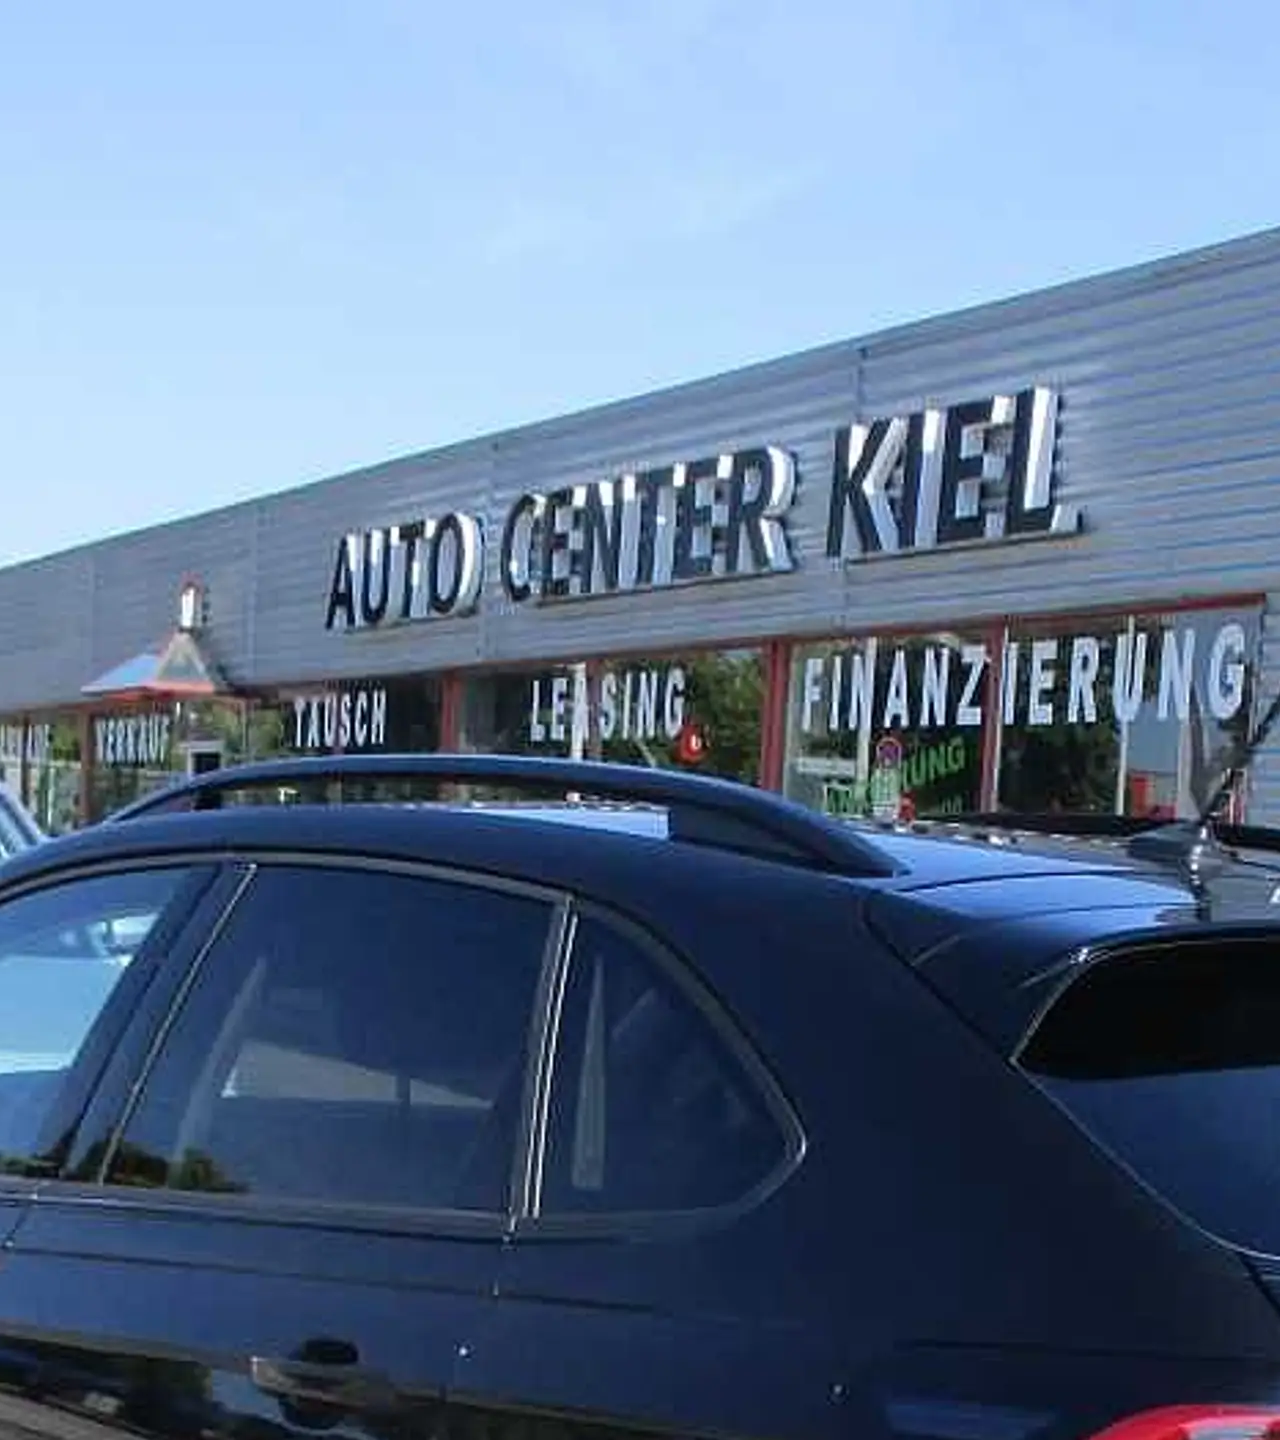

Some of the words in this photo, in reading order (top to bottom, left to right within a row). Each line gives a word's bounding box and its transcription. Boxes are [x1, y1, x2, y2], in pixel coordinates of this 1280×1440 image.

[325, 511, 486, 632] AUTO
[500, 444, 800, 599] CENTER
[825, 385, 1085, 563] KIEL
[292, 687, 388, 749] TAUSCH
[530, 665, 687, 743] LEASING
[801, 622, 1248, 731] FINANZIERUNG
